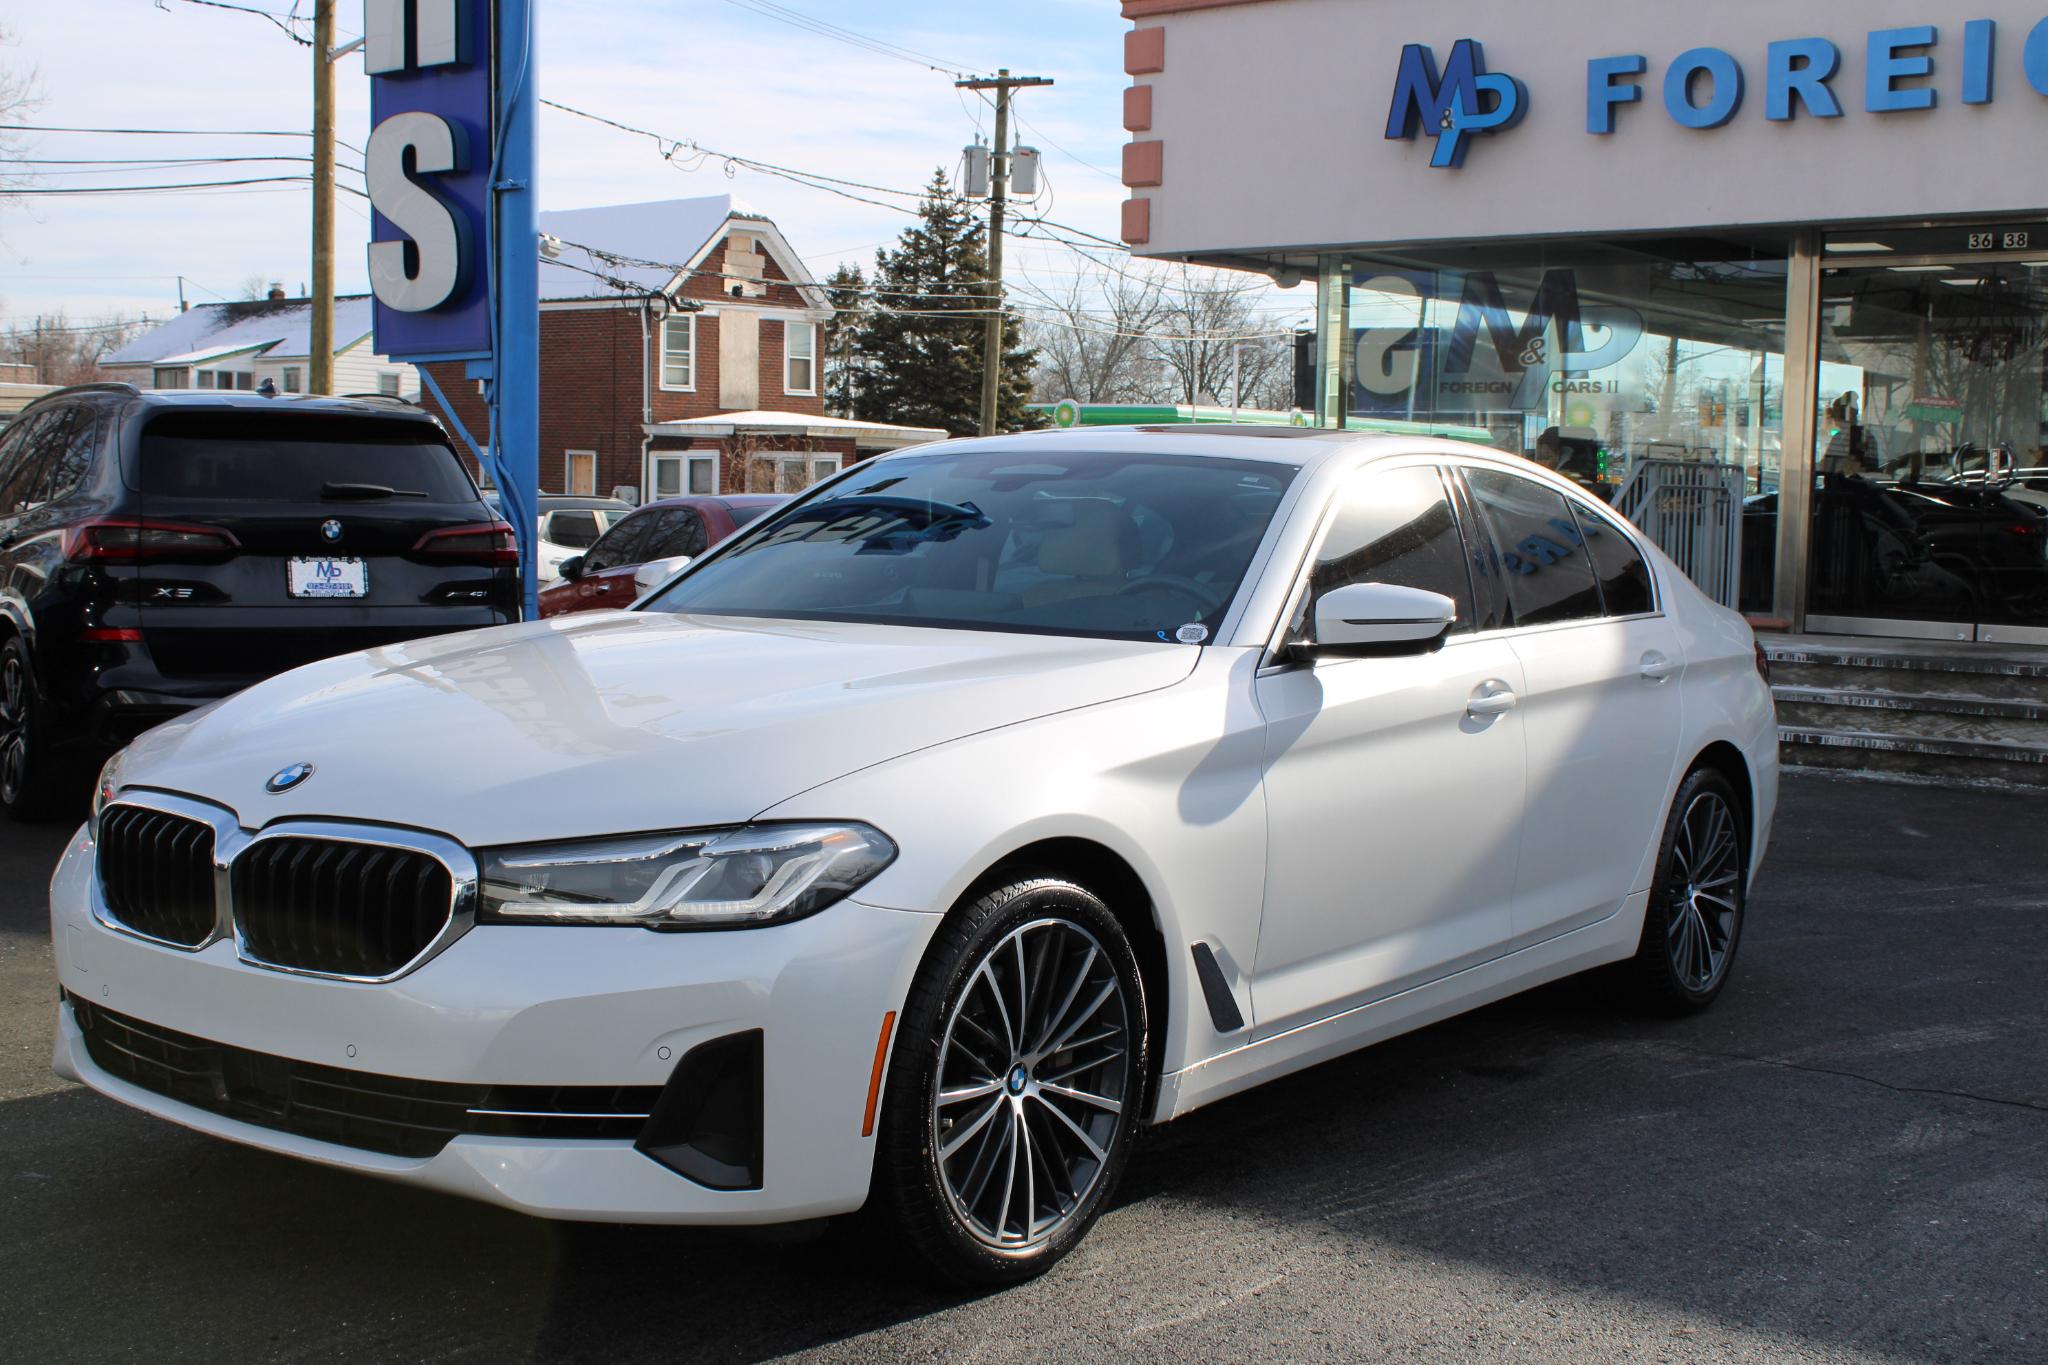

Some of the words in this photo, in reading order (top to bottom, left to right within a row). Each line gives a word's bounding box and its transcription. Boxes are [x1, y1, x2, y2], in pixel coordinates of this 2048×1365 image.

[1970, 233, 1991, 248] 36
[2005, 233, 2027, 247] 38
[1439, 381, 1513, 394] FOREIGN
[1551, 381, 1603, 394] CARS
